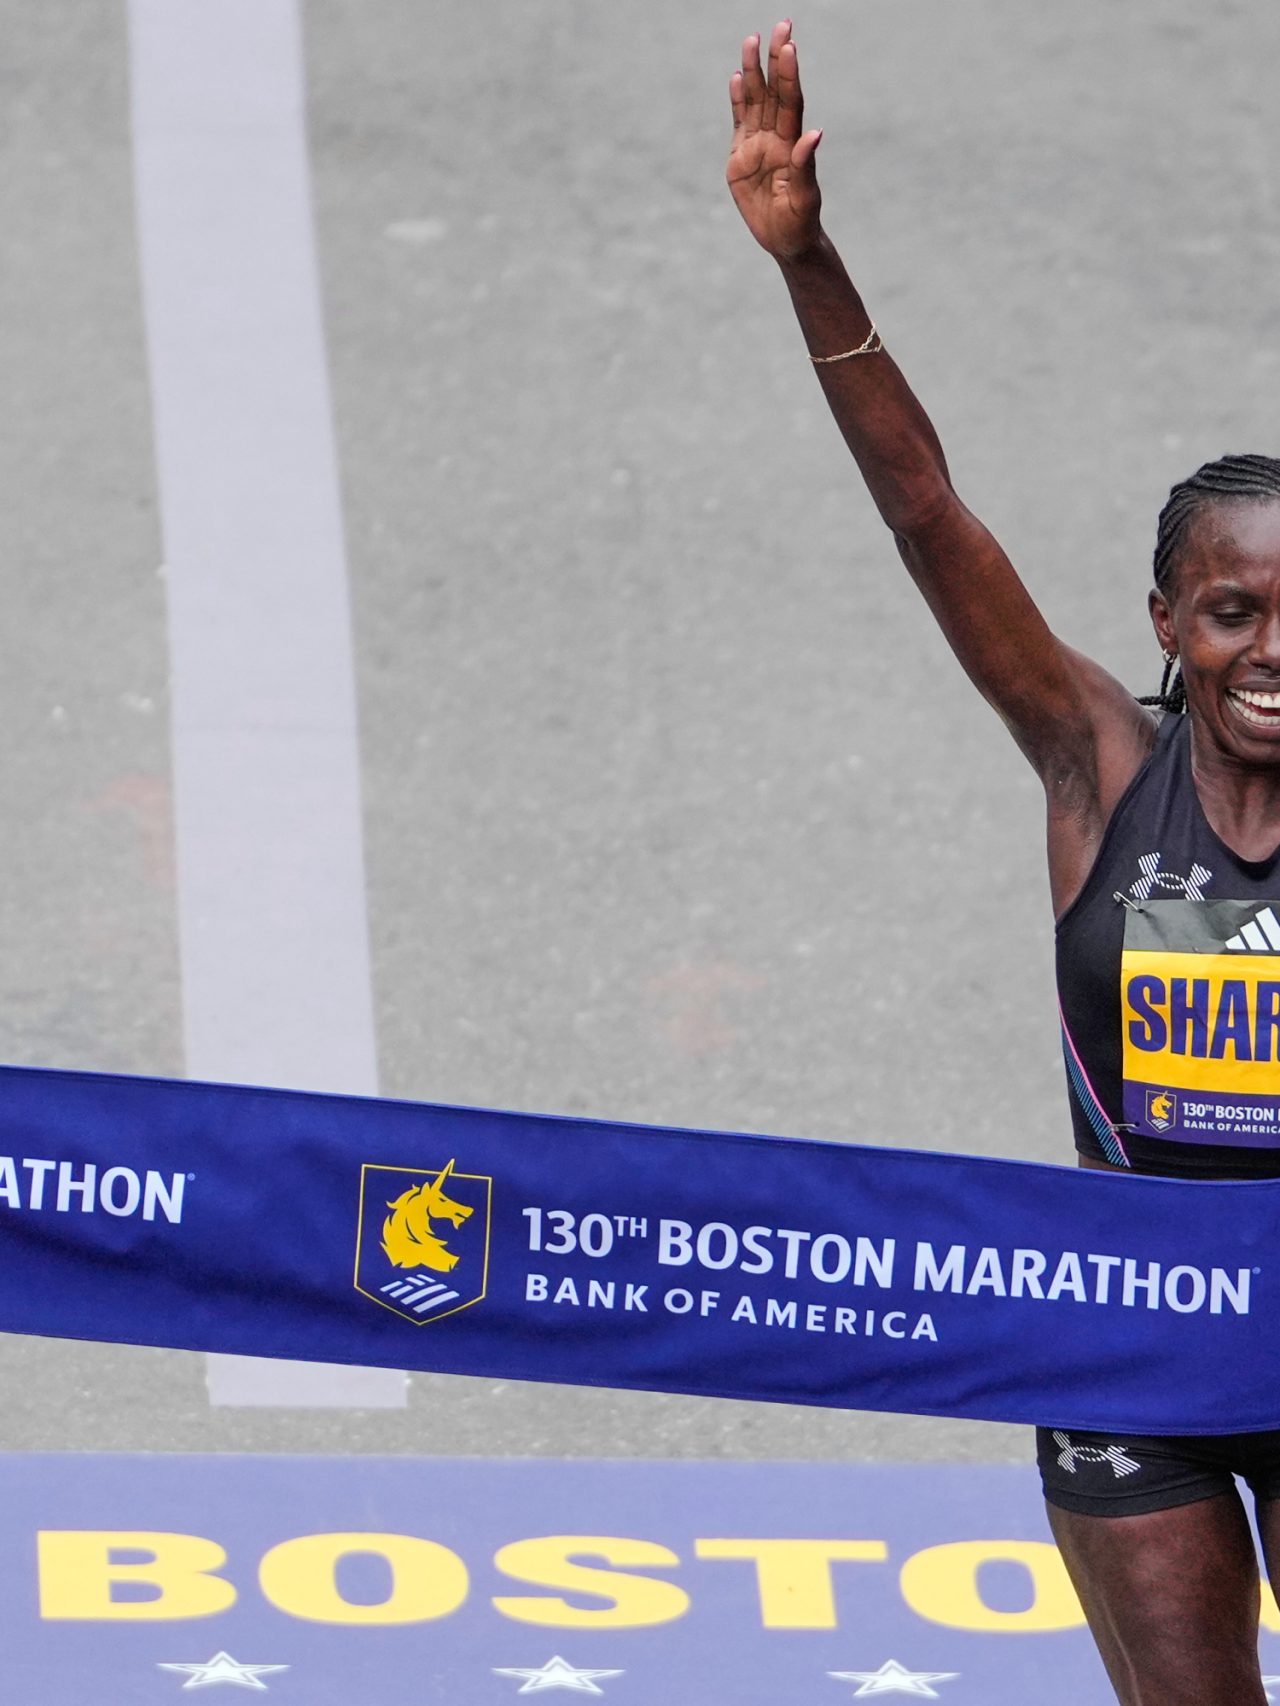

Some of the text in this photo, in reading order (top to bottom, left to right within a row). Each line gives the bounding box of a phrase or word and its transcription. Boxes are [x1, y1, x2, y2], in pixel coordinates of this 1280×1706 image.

[1182, 1102, 1214, 1117] 130TH
[1215, 1105, 1274, 1121] BOSTON
[1183, 1119, 1214, 1130] BANK
[1217, 1122, 1231, 1132] OF
[522, 1207, 1252, 1315] 130TH BOSTON MARATHON
[525, 1273, 939, 1342] BANK OF AMERICA
